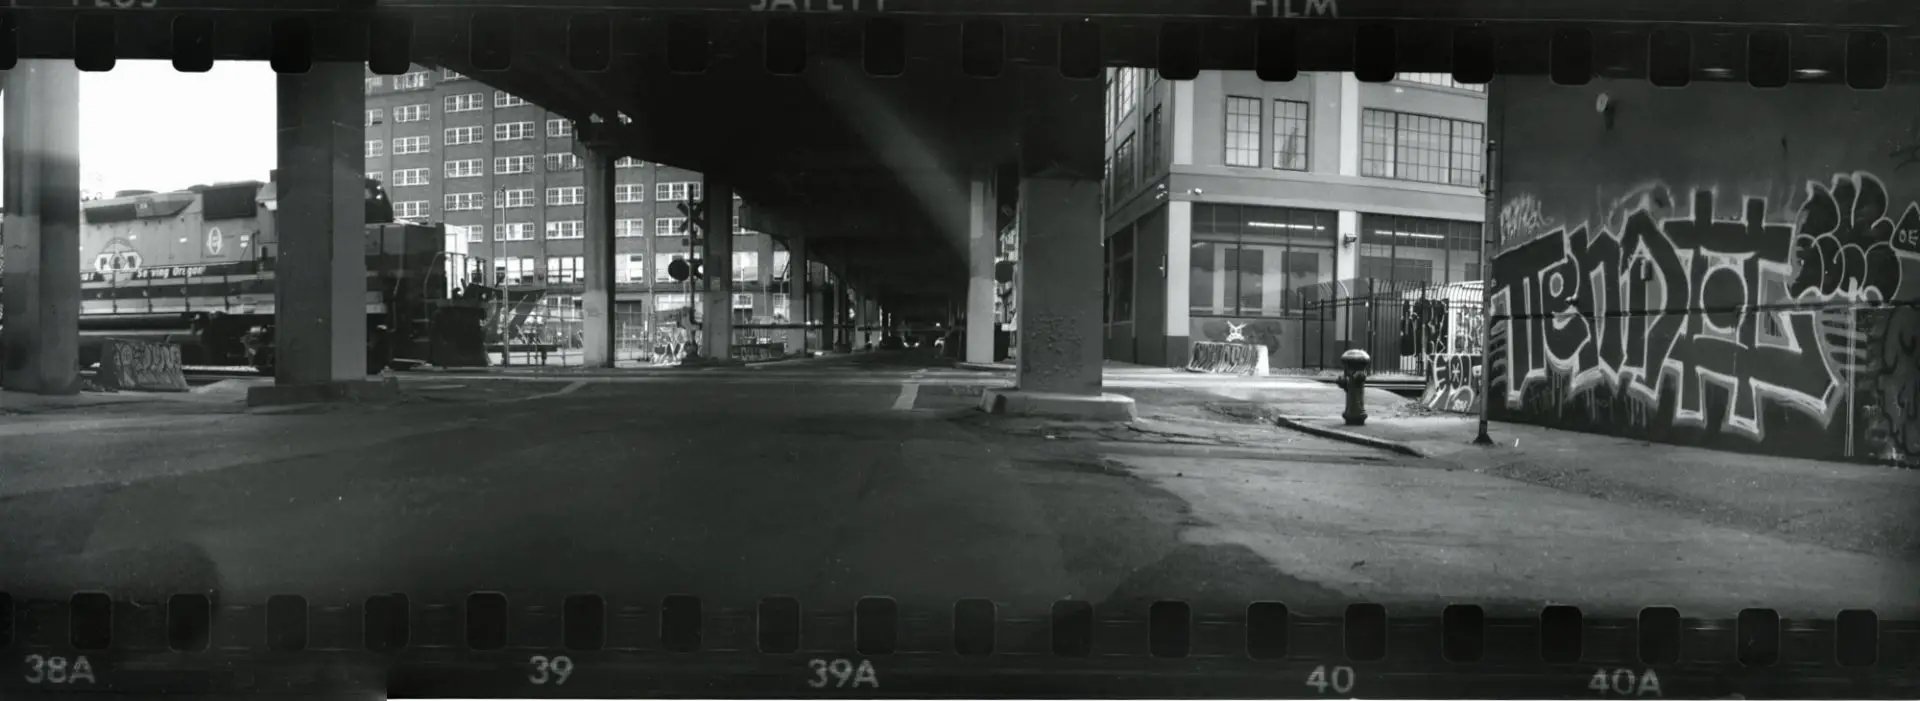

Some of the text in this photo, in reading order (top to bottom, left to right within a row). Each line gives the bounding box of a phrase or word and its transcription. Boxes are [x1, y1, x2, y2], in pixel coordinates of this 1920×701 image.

[1250, 0, 1338, 18] FILM
[137, 267, 170, 279] Seving
[24, 655, 95, 684] 38A
[528, 655, 574, 685] 39
[807, 659, 879, 689] 39A
[1305, 665, 1355, 694] 40
[1588, 668, 1662, 697] 40A
